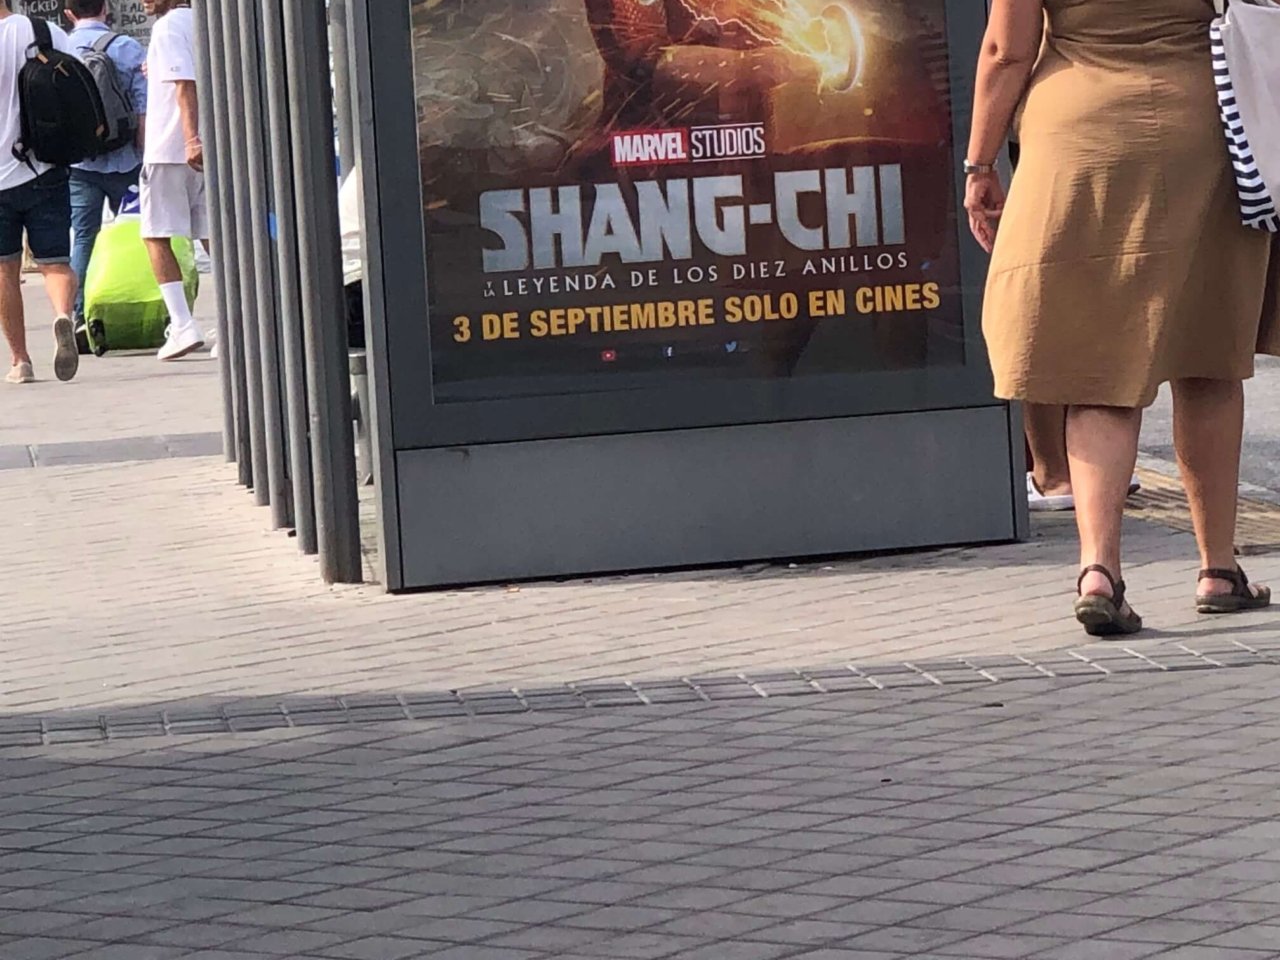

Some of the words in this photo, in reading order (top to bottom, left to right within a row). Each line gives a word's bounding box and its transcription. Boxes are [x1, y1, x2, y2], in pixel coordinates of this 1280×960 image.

[121, 14, 148, 27] BAD
[613, 132, 686, 162] MARVEL
[691, 126, 765, 158] STUDIOS
[479, 163, 905, 273] SHANG-CHI
[503, 273, 615, 296] LEYENDA
[631, 269, 658, 287] DE
[674, 265, 718, 284] LOS
[733, 260, 786, 280] DIEZ
[802, 251, 908, 276] ANILLOS
[453, 316, 471, 342] 3
[482, 312, 520, 340] DE
[530, 298, 715, 337] SEPTIEMBRE
[725, 292, 798, 323] SOLO
[808, 289, 846, 317] EN
[855, 281, 941, 314] CINES
